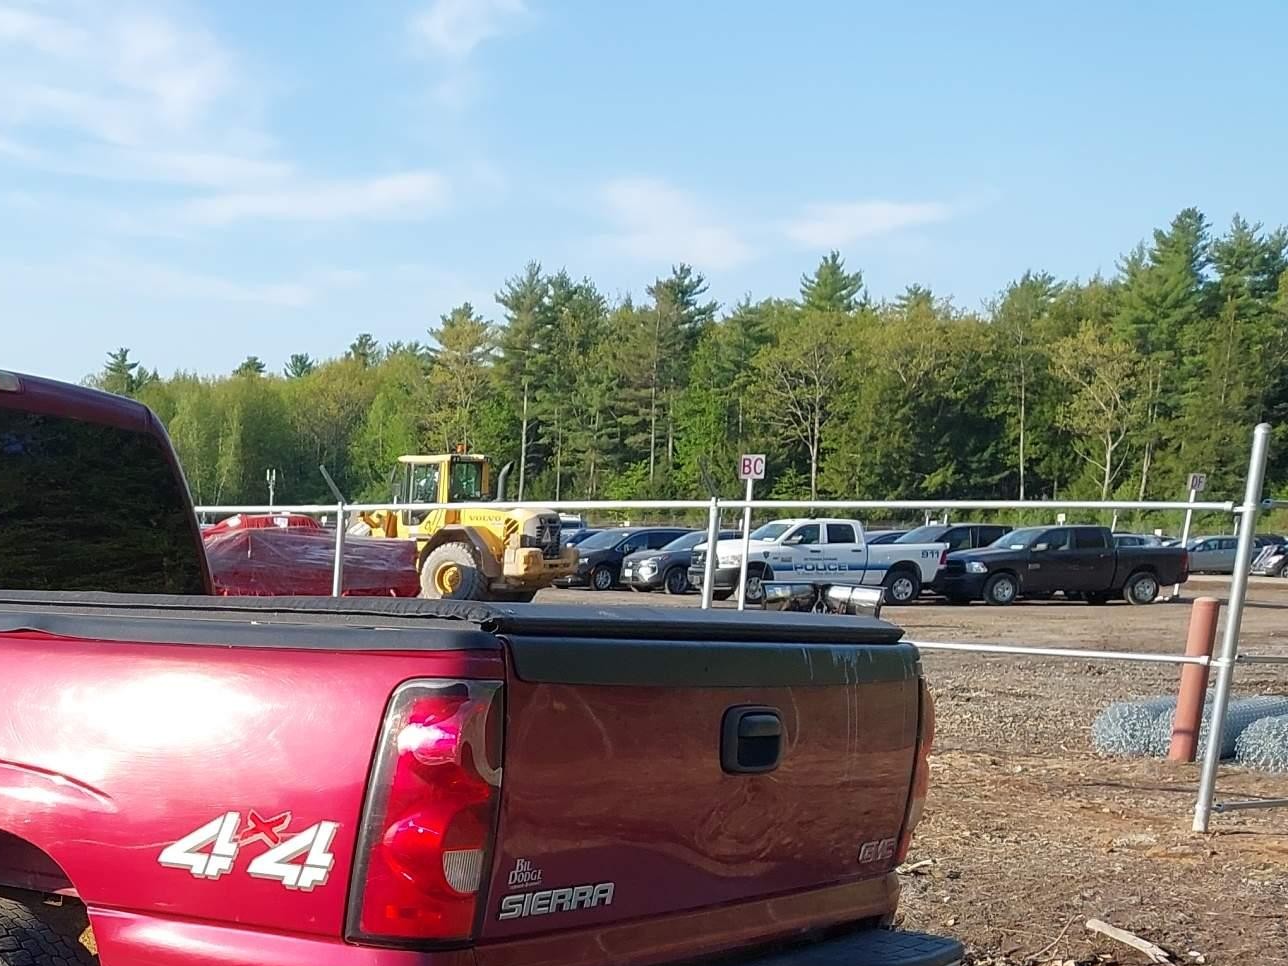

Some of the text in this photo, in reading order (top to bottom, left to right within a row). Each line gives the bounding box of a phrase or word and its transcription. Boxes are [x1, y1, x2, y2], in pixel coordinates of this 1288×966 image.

[742, 457, 764, 475] BC
[921, 549, 940, 559] 911
[793, 562, 848, 572] POLICE
[499, 882, 615, 921] SIERRA
